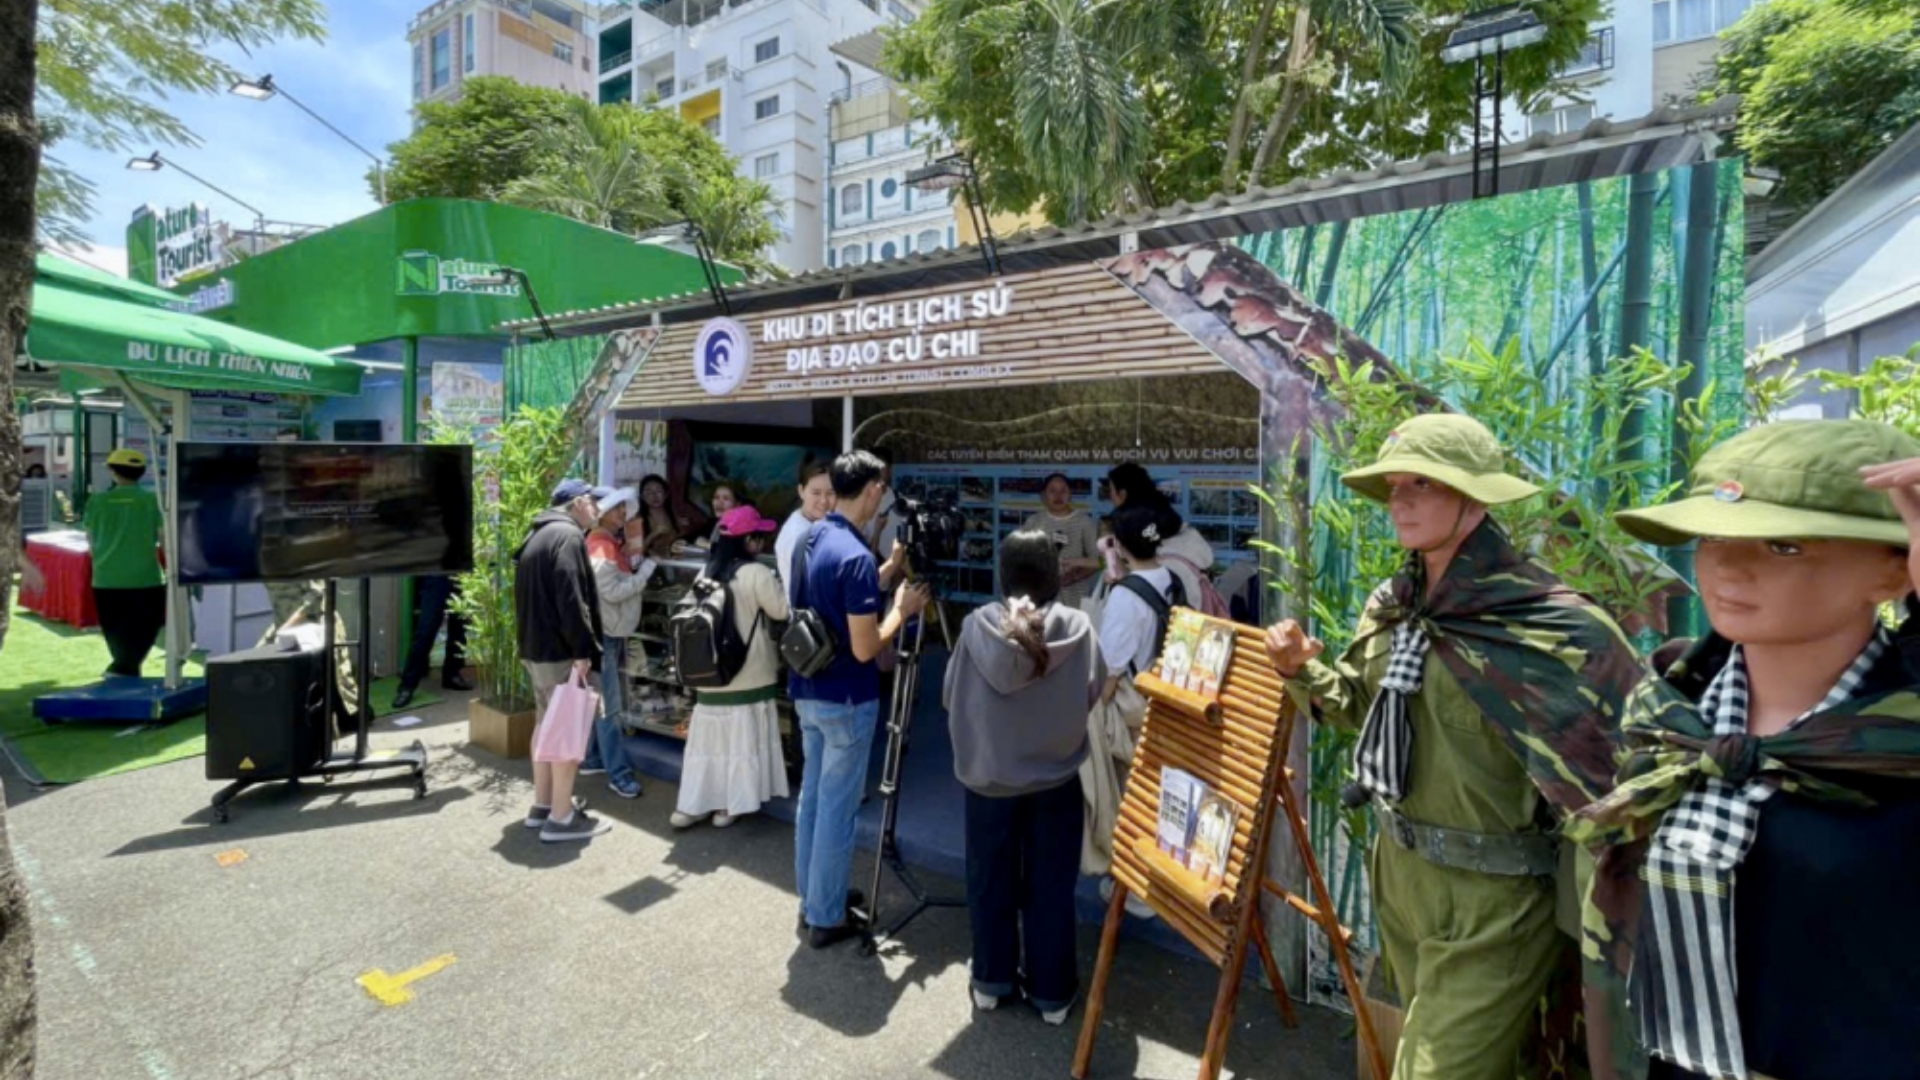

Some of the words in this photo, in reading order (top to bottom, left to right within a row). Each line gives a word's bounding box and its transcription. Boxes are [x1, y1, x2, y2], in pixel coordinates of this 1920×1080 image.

[158, 228, 213, 281] Tourist
[763, 316, 805, 342] KHU
[811, 313, 833, 337] DI
[841, 300, 895, 334] TÍCH
[903, 295, 963, 331] LỊCH
[971, 283, 1014, 318] SỬ
[127, 341, 159, 361] DU
[165, 346, 211, 370] LỊCH
[786, 346, 824, 375] ĐỊA
[829, 340, 880, 371] ĐẠO
[887, 326, 923, 362] CỦ
[930, 329, 981, 358] CHI
[926, 448, 948, 460] CÁC
[1017, 449, 1052, 460] THAM
[1053, 449, 1089, 461] QUAN
[1091, 447, 1111, 460] VÀ
[1113, 448, 1146, 462] DỊCH
[1149, 448, 1170, 461] VỤ
[1173, 448, 1198, 460] VUI
[1202, 446, 1240, 460] CHƠI
